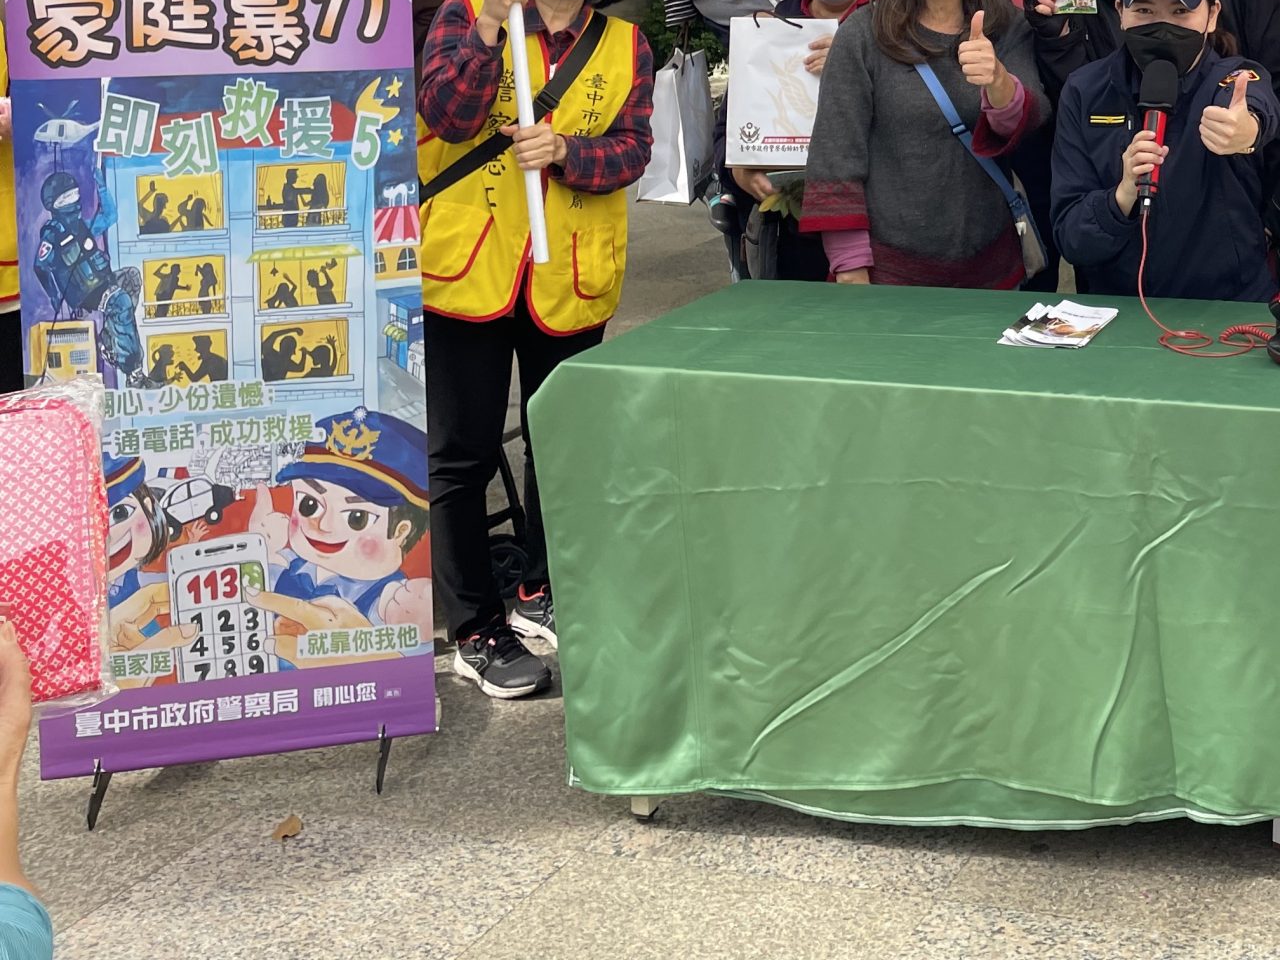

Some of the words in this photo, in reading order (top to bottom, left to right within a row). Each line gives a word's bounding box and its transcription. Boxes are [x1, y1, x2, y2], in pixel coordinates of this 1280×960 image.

[95, 78, 382, 178] 即刻救援5
[186, 567, 240, 604] 113
[217, 609, 236, 632] 2
[244, 607, 260, 630] 3
[190, 636, 209, 657] 4
[222, 635, 236, 654] 5
[247, 633, 260, 651] 6
[75, 689, 299, 737] 臺中市政府警察局
[313, 682, 377, 708] 關心您
